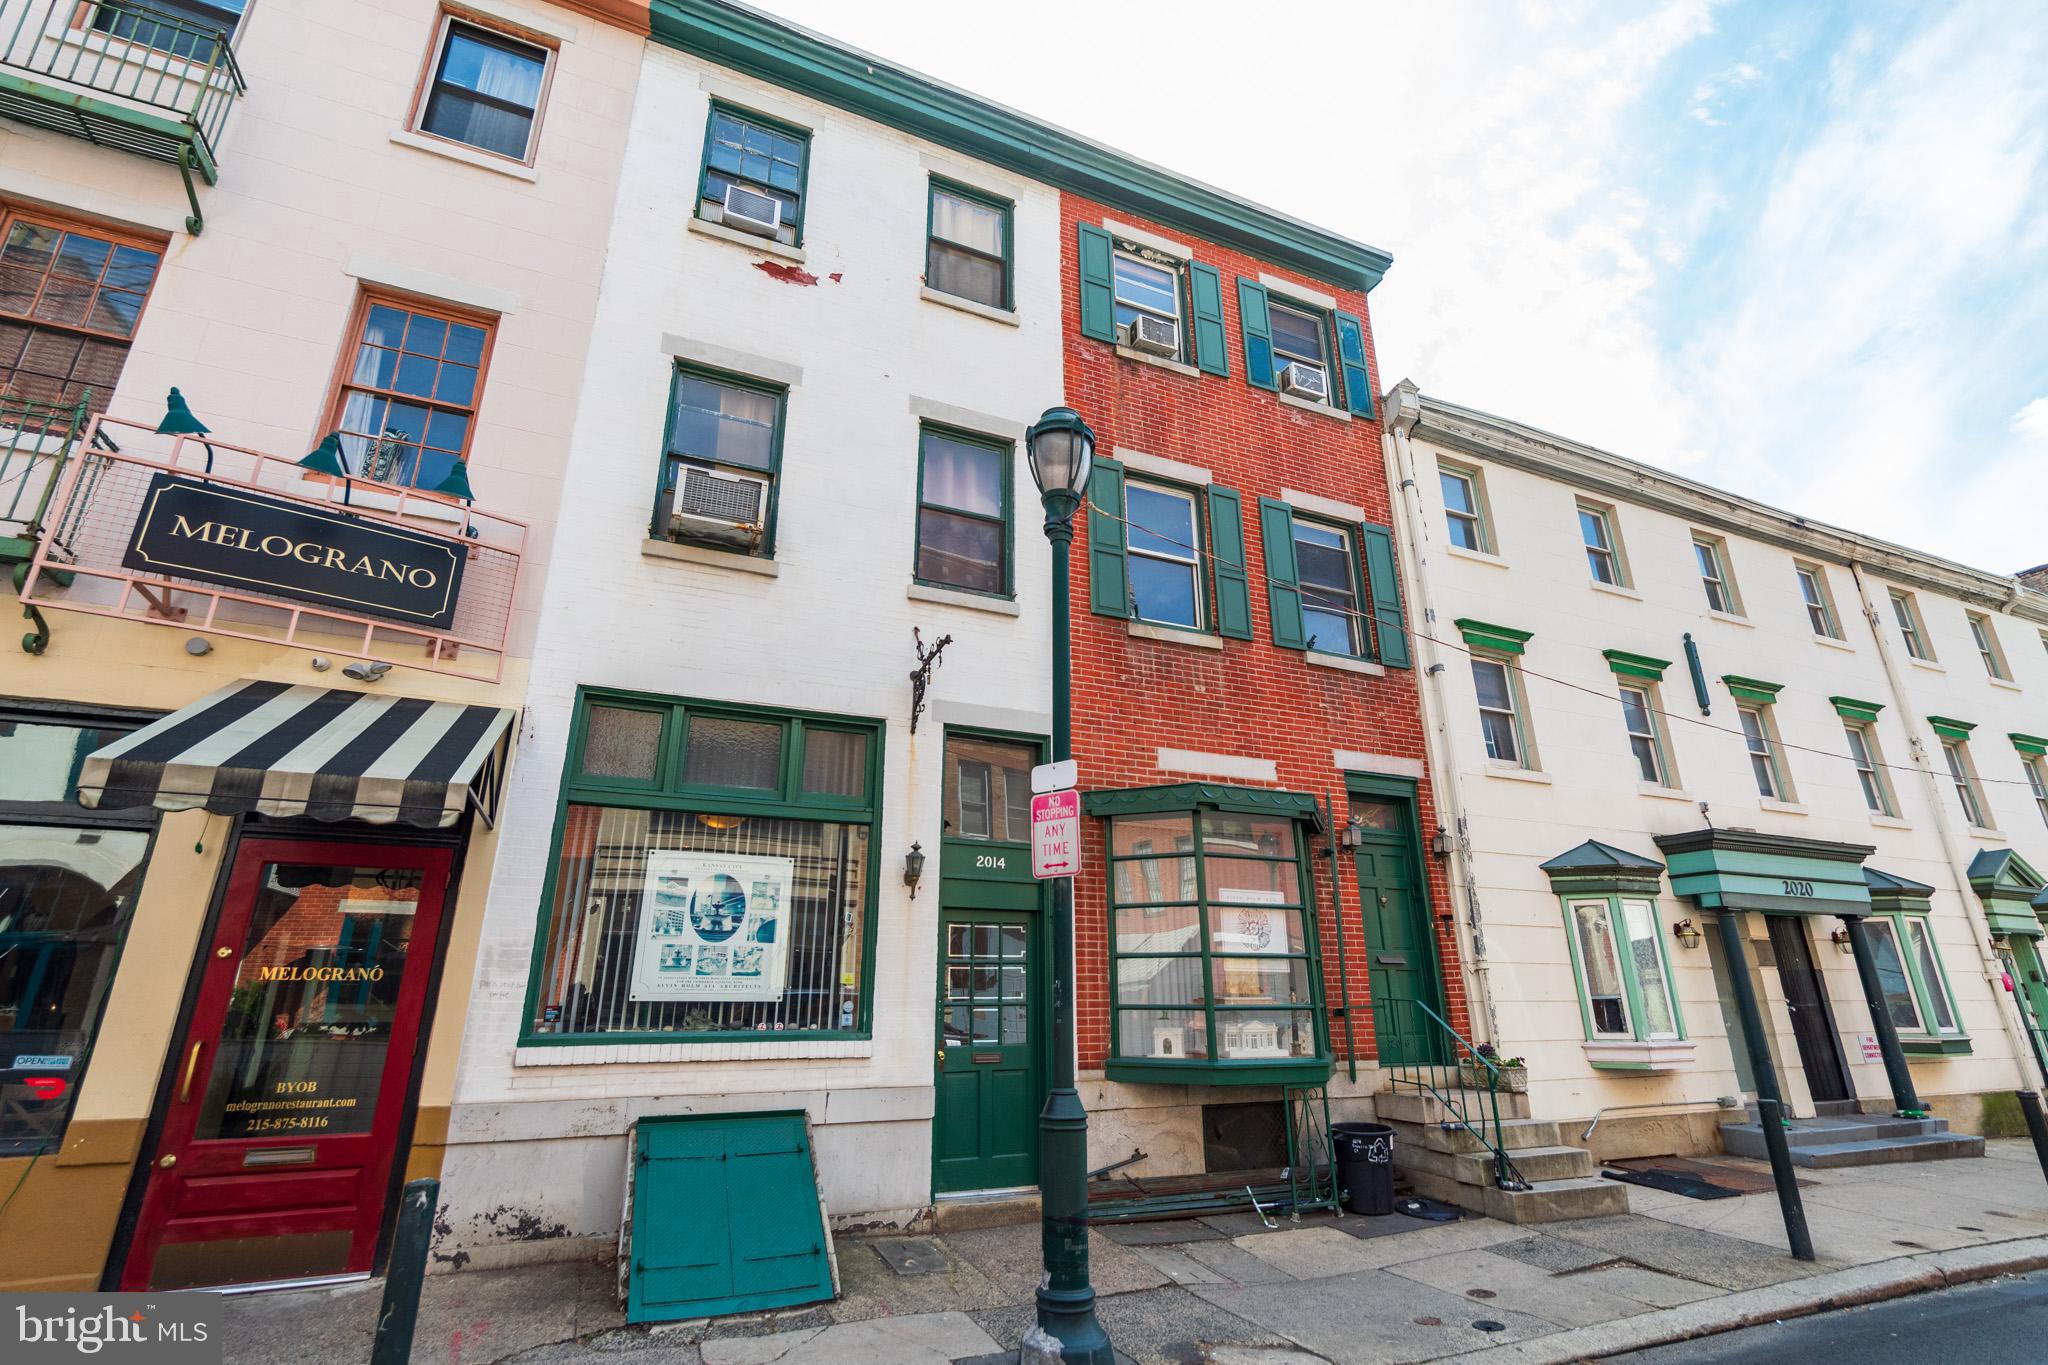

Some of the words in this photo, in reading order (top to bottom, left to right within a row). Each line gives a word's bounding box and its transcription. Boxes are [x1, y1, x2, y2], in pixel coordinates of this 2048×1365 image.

[168, 514, 437, 589] MELOGRANO
[1048, 795, 1061, 807] NO
[1036, 805, 1074, 821] STOPPING
[1044, 823, 1066, 838] ANY
[1042, 841, 1070, 857] TIME
[976, 855, 1006, 869] 2014
[1782, 880, 1814, 897] 2020
[275, 1081, 317, 1094] BYOB
[226, 1097, 357, 1113] melogranorestaurant.com
[246, 1116, 329, 1131] 215-875-8116
